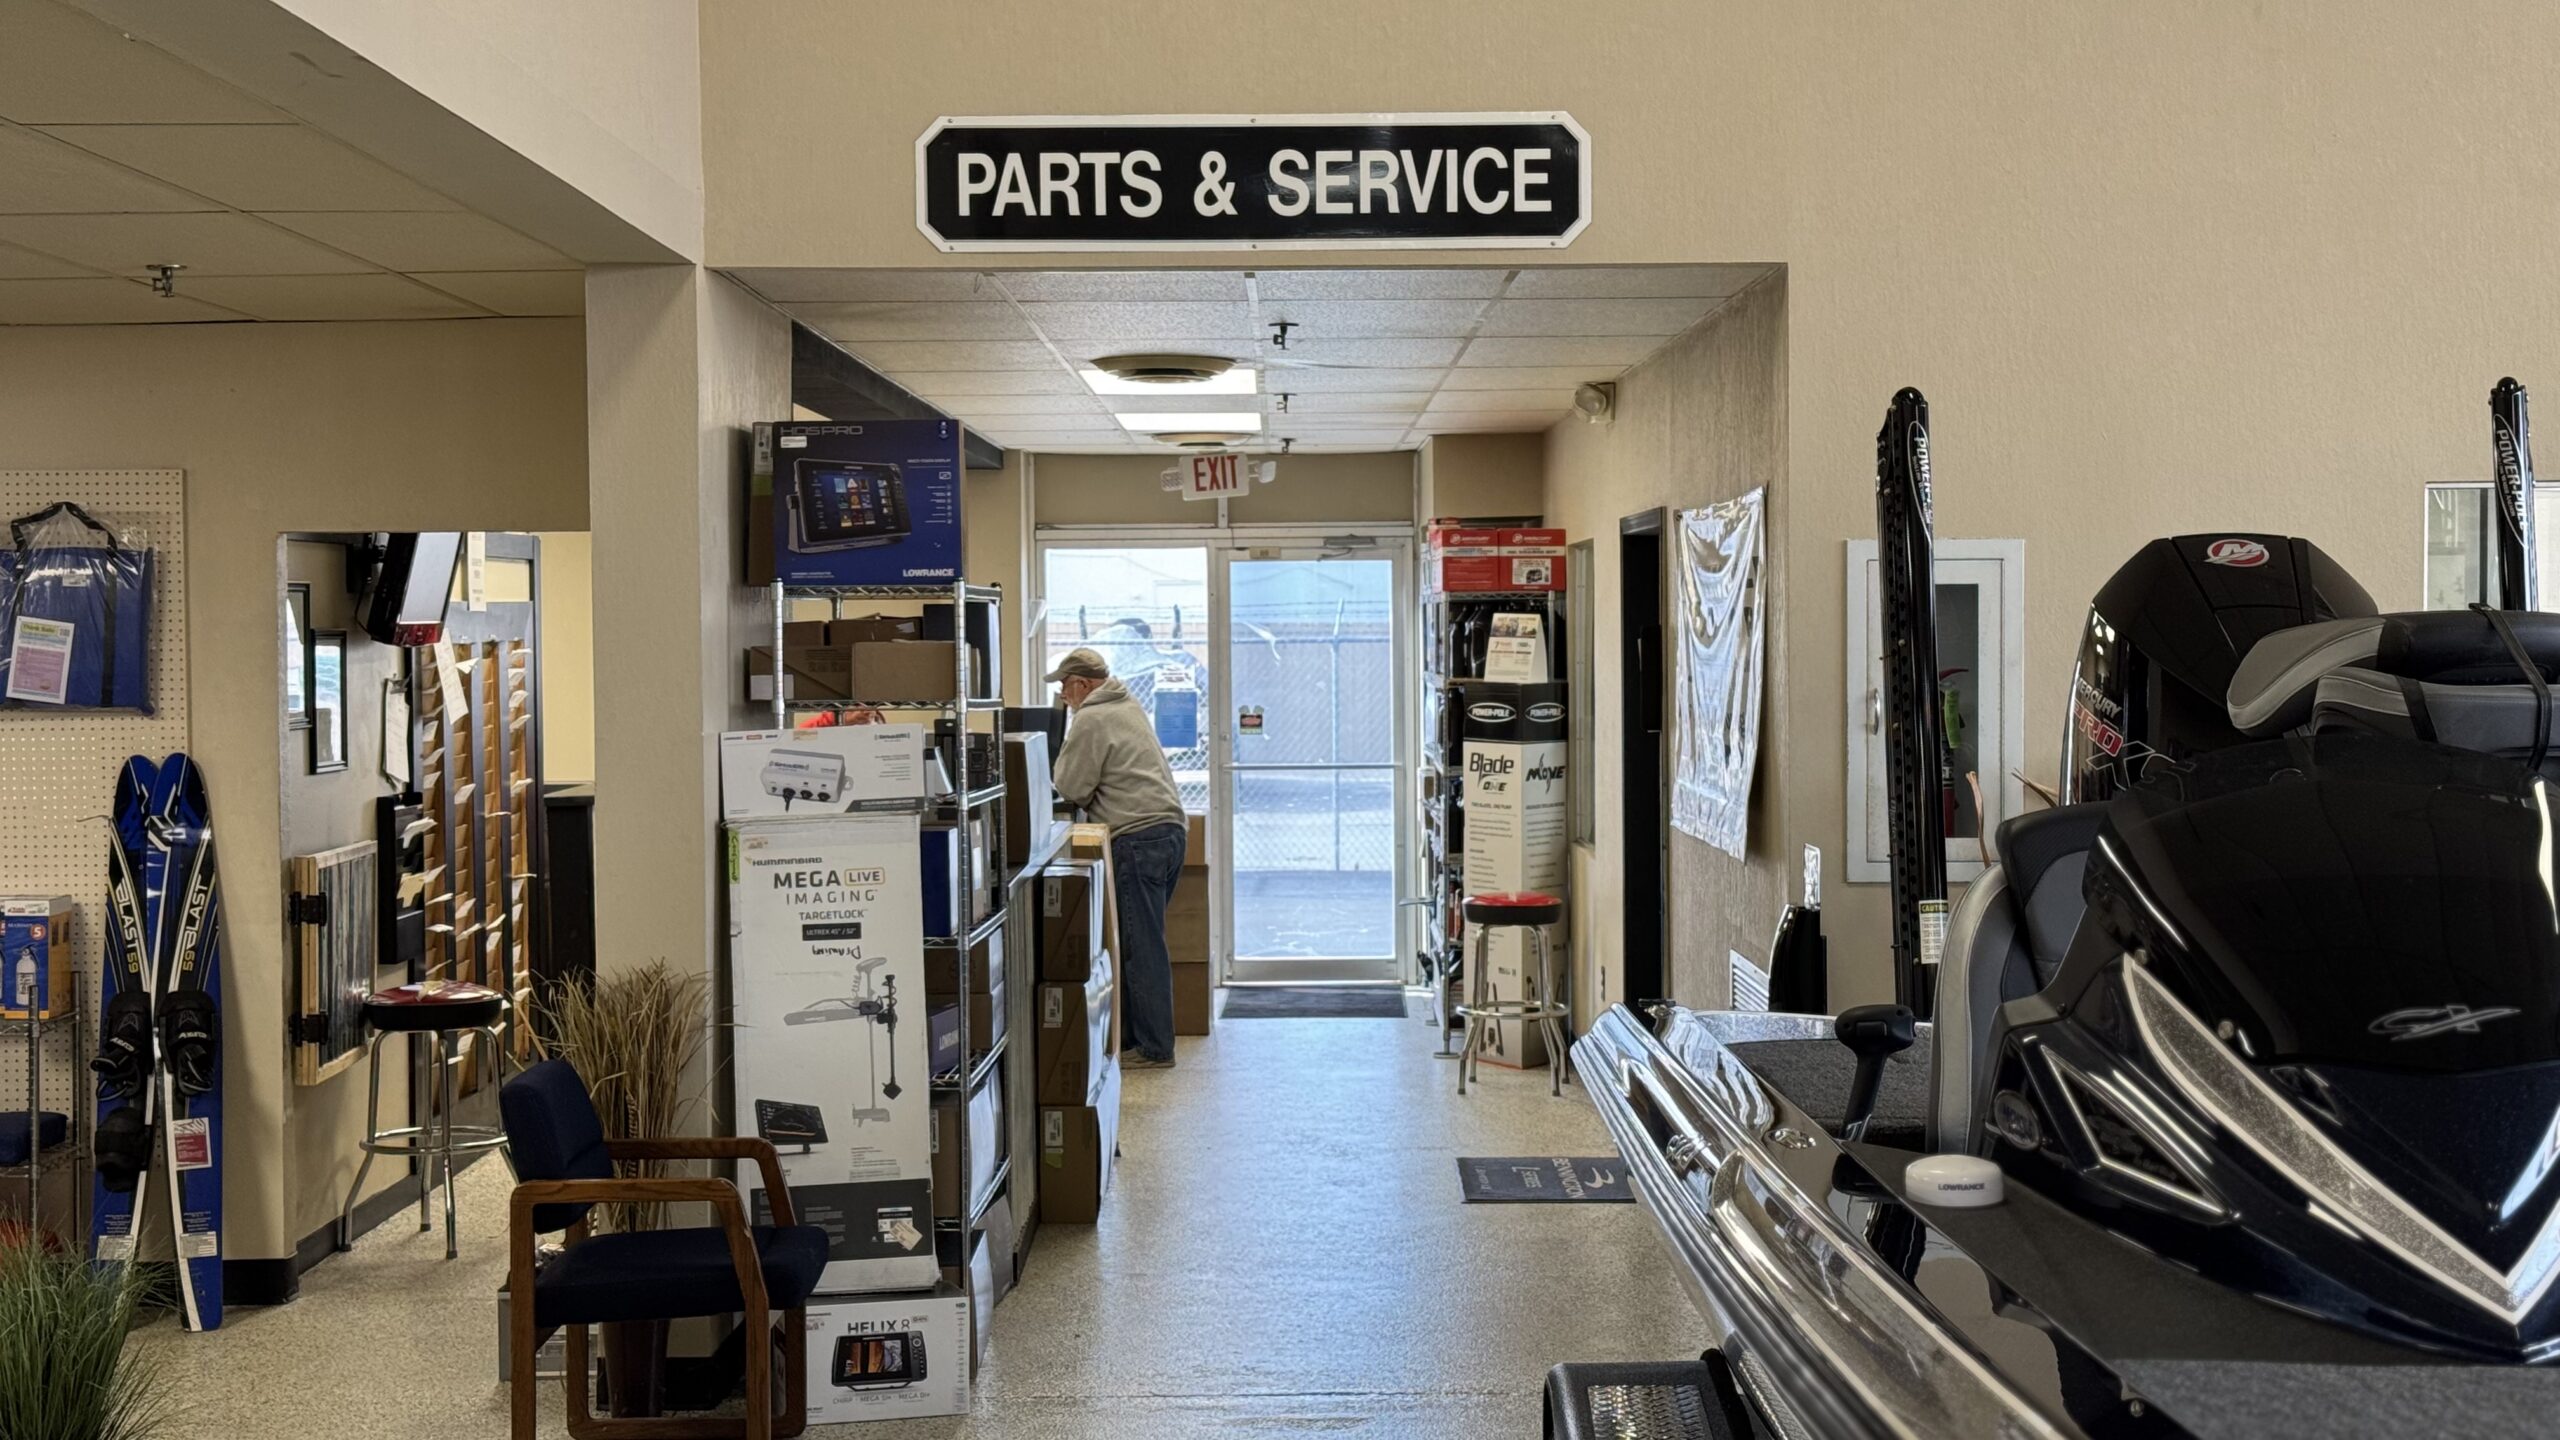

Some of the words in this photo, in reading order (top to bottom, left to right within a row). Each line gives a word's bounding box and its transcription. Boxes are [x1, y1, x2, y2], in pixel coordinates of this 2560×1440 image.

[957, 151, 1163, 218] PARTS
[1193, 150, 1238, 217] &
[1267, 146, 1553, 216] SERVICE
[1193, 454, 1239, 492] EXIT
[902, 568, 955, 577] LOWRANCE
[1469, 752, 1515, 788] Blade
[752, 857, 823, 867] HUMMINBIRD
[773, 869, 841, 889] MEGA
[849, 870, 881, 883] LIVE
[785, 889, 876, 905] IMAGING
[114, 877, 140, 949] BLAST
[185, 874, 209, 950] BLAST
[798, 910, 865, 921] TARGETLOCK
[33, 927, 42, 938] 5
[126, 950, 140, 974] 59
[182, 950, 196, 973] 59
[1552, 1158, 1587, 1199] BENNINGTON
[1937, 1183, 1985, 1191] LOWRANCE
[847, 1320, 898, 1334] HELIX
[901, 1319, 911, 1330] 8
